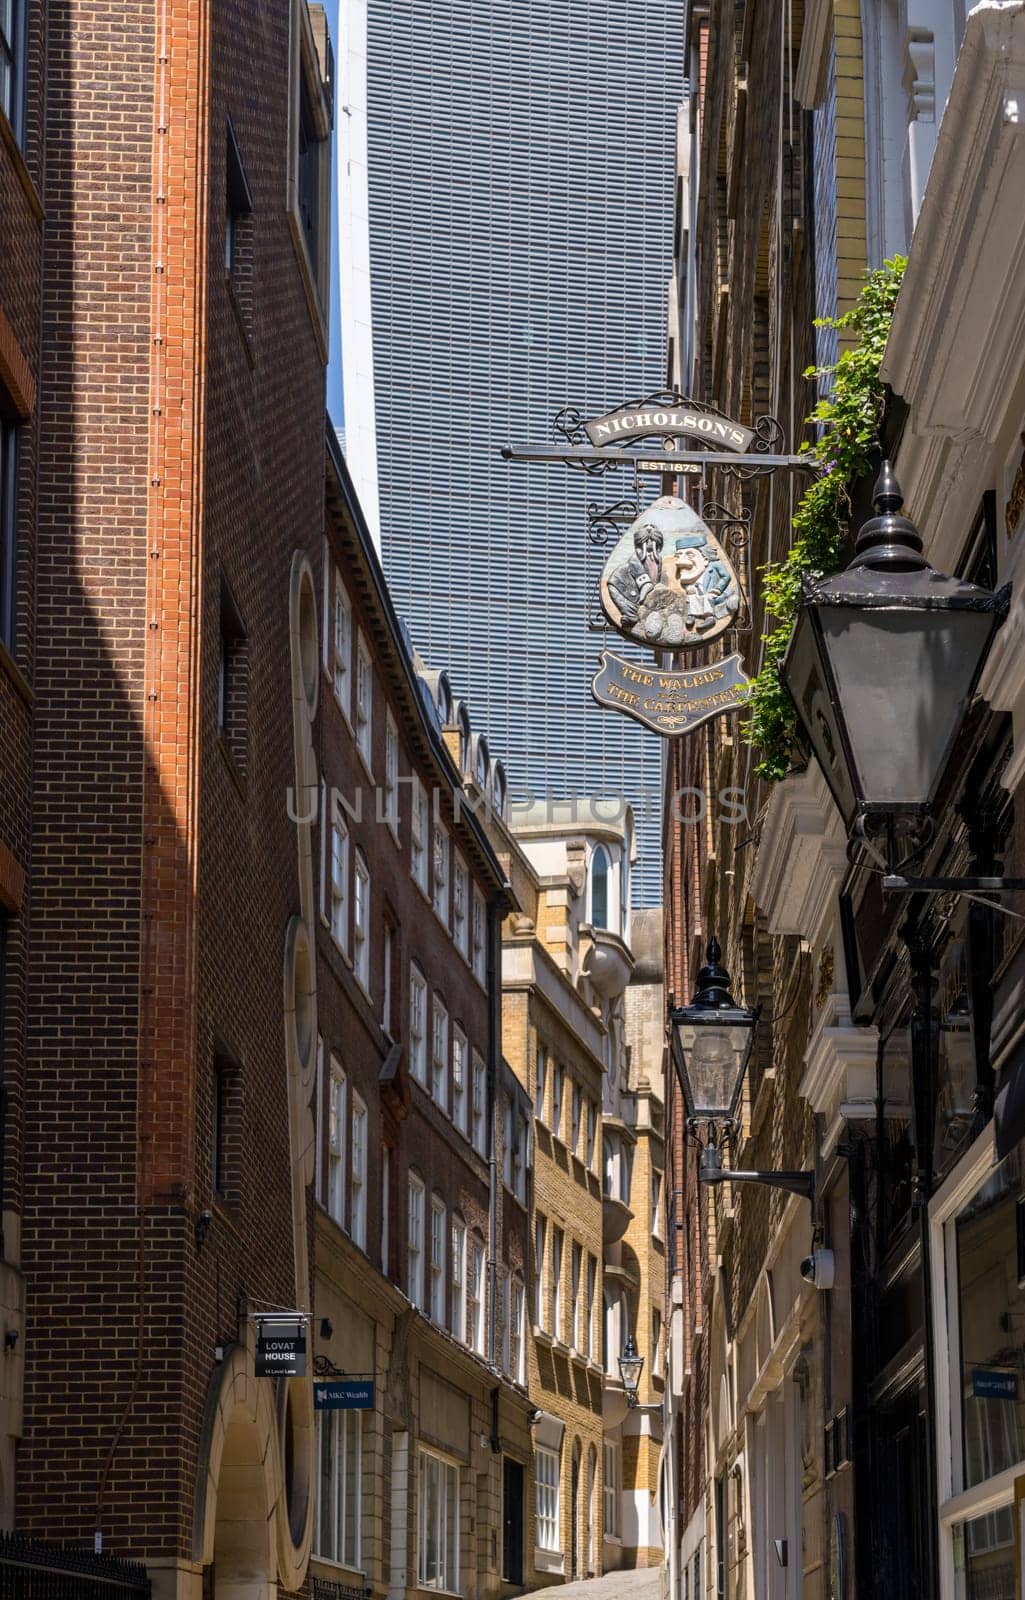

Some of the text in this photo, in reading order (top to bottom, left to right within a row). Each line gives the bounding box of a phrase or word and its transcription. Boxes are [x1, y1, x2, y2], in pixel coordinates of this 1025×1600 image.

[594, 412, 745, 446] NICHOLSON'S
[641, 462, 699, 472] EST. 1873
[622, 666, 725, 690] THE WALRUS
[607, 682, 640, 705] THE
[265, 1342, 296, 1350] LOVAT
[265, 1352, 296, 1360] HOUSE
